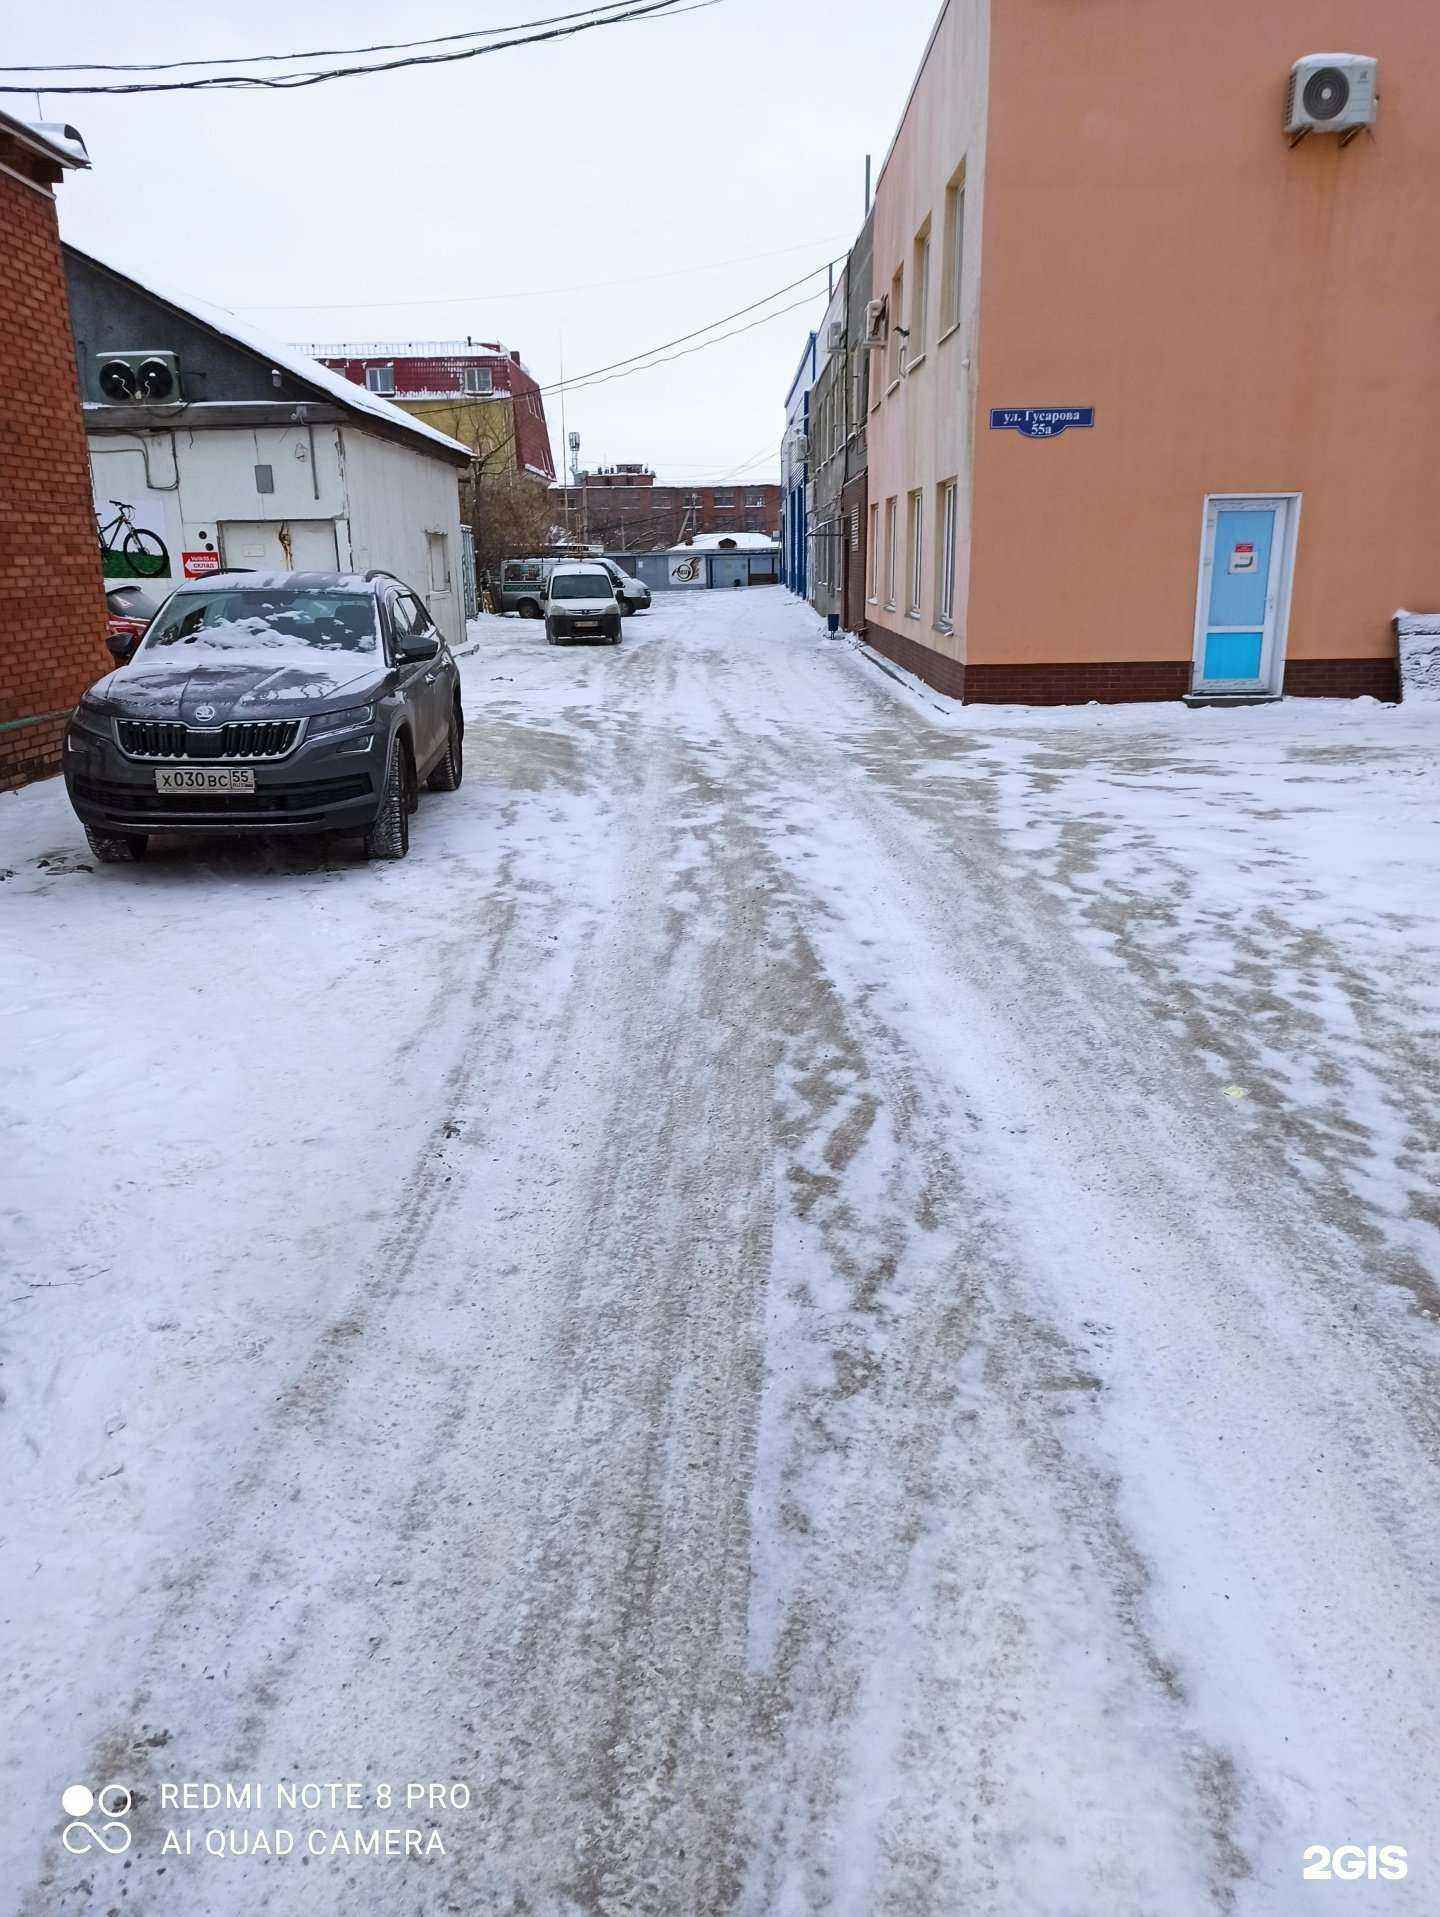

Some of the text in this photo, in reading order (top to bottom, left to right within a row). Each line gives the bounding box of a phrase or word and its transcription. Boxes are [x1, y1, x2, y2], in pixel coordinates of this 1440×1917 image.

[1003, 410, 1080, 425] ул. Гусарова
[1031, 423, 1052, 435] 55а
